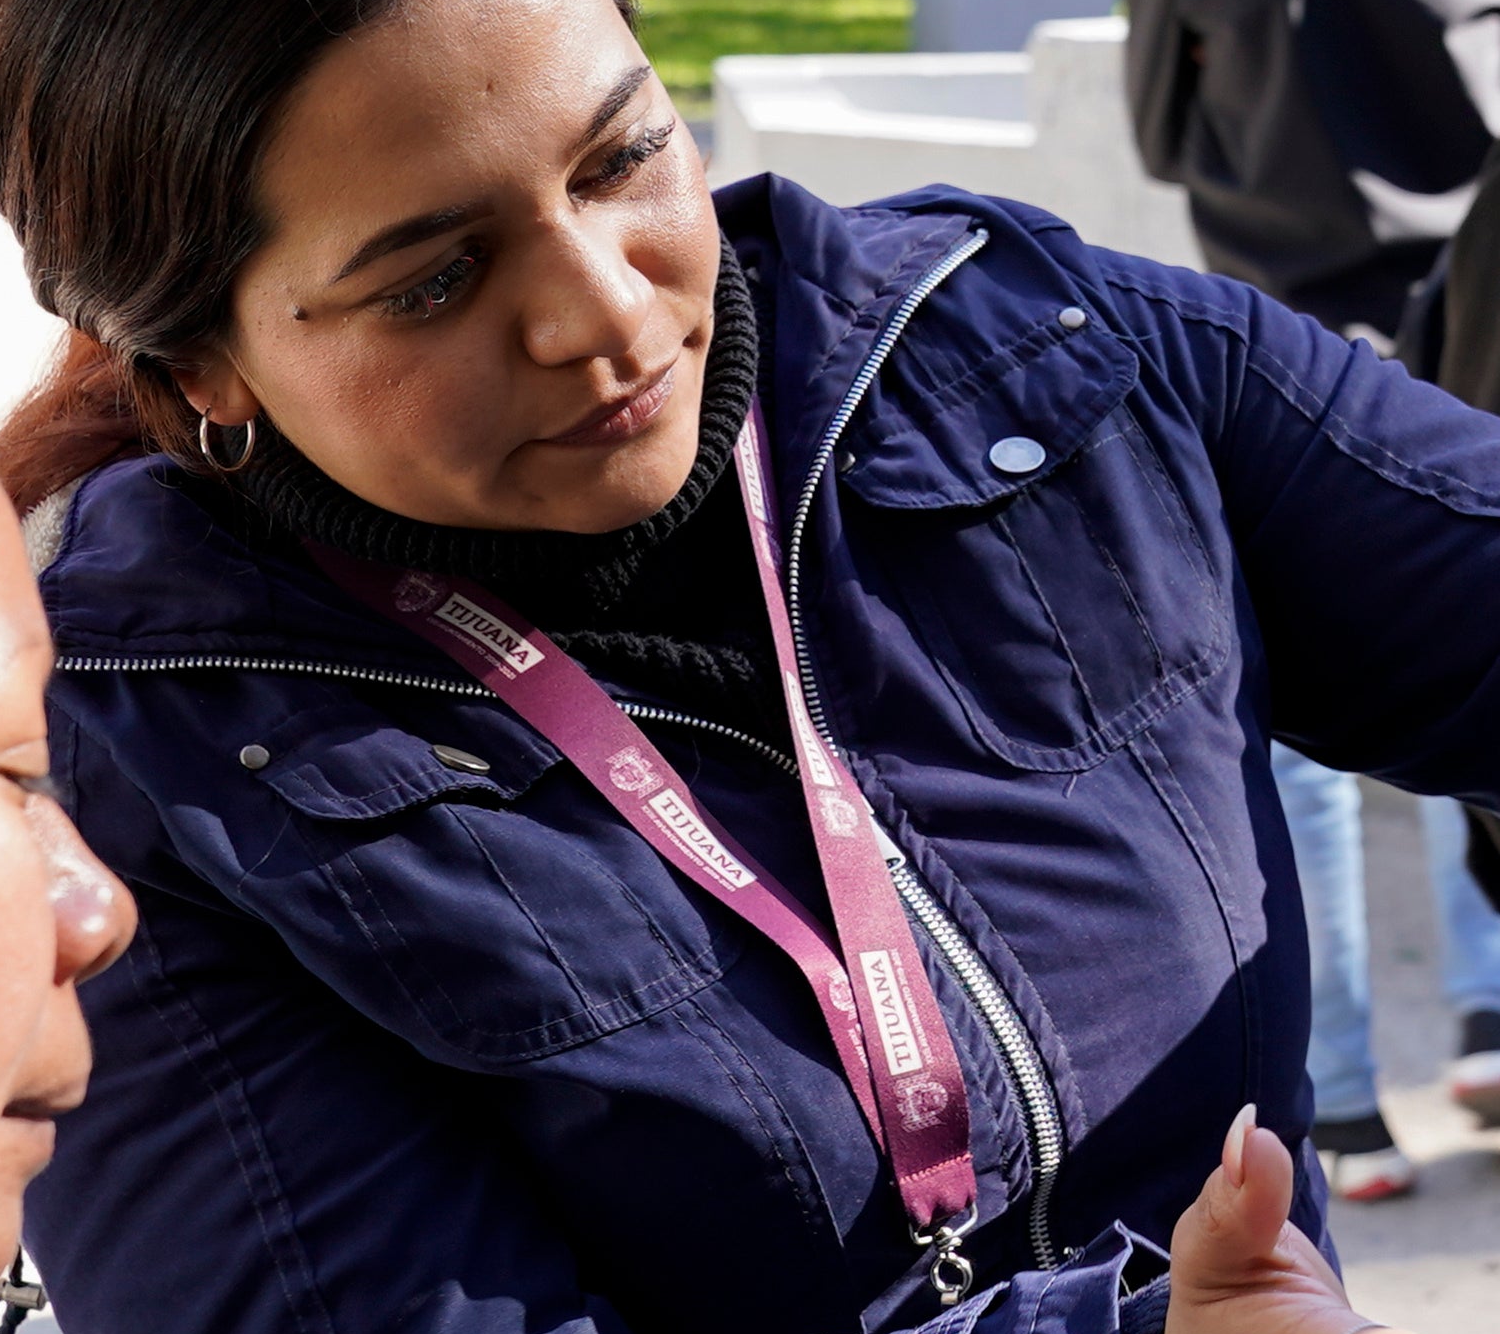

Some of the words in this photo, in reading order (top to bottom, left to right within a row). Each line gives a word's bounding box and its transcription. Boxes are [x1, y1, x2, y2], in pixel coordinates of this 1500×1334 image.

[741, 431, 763, 513] TIJUAN
[445, 601, 530, 666] TIJUANA
[661, 796, 743, 881] TIJUANA
[870, 958, 912, 1068] TIJUANA
